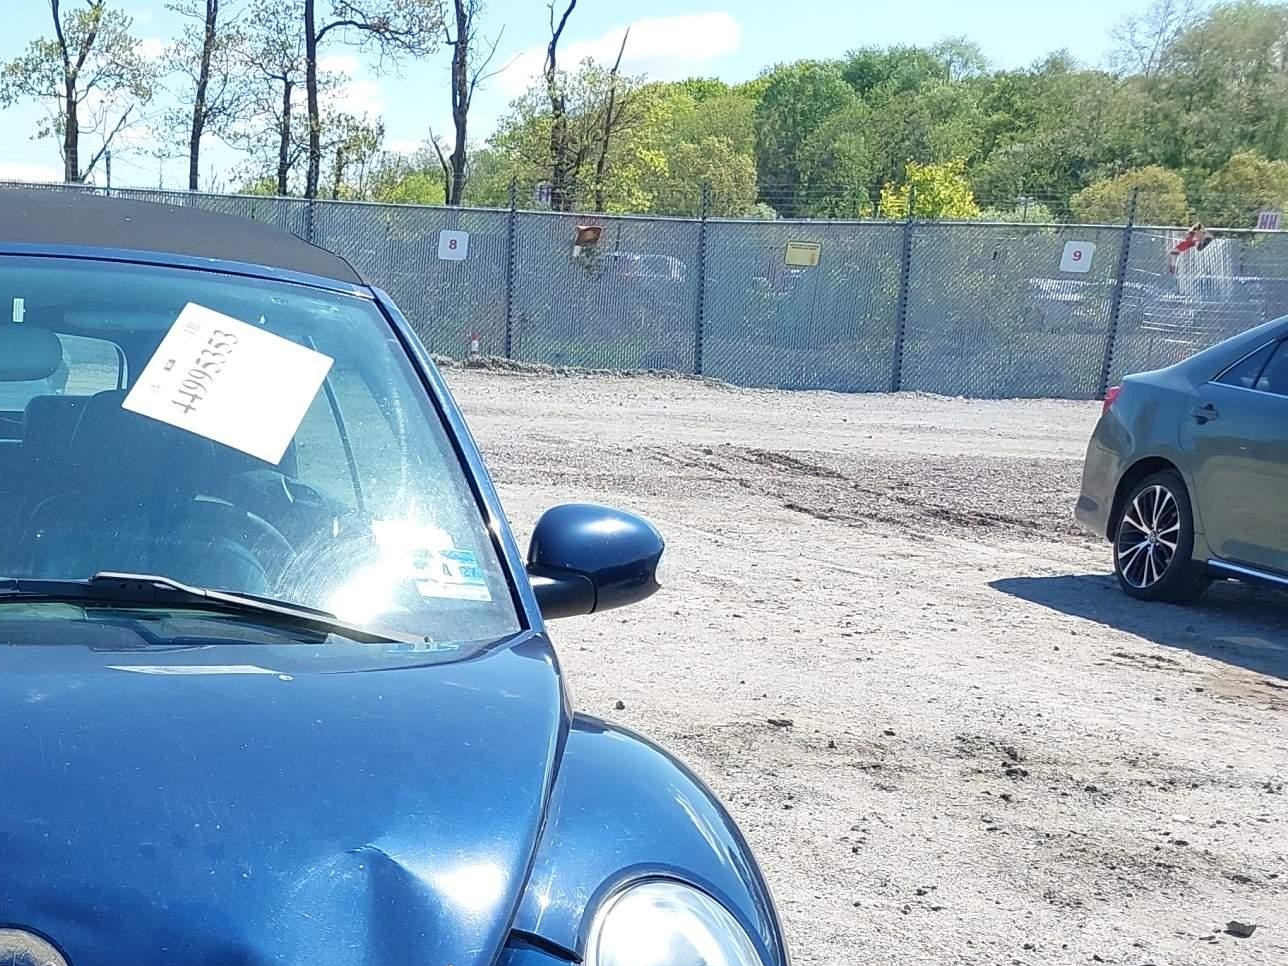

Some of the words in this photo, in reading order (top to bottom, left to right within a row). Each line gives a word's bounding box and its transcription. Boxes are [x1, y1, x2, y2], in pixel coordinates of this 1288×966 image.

[448, 239, 458, 250] 8
[1072, 250, 1082, 262] 9
[170, 329, 239, 414] 44995353
